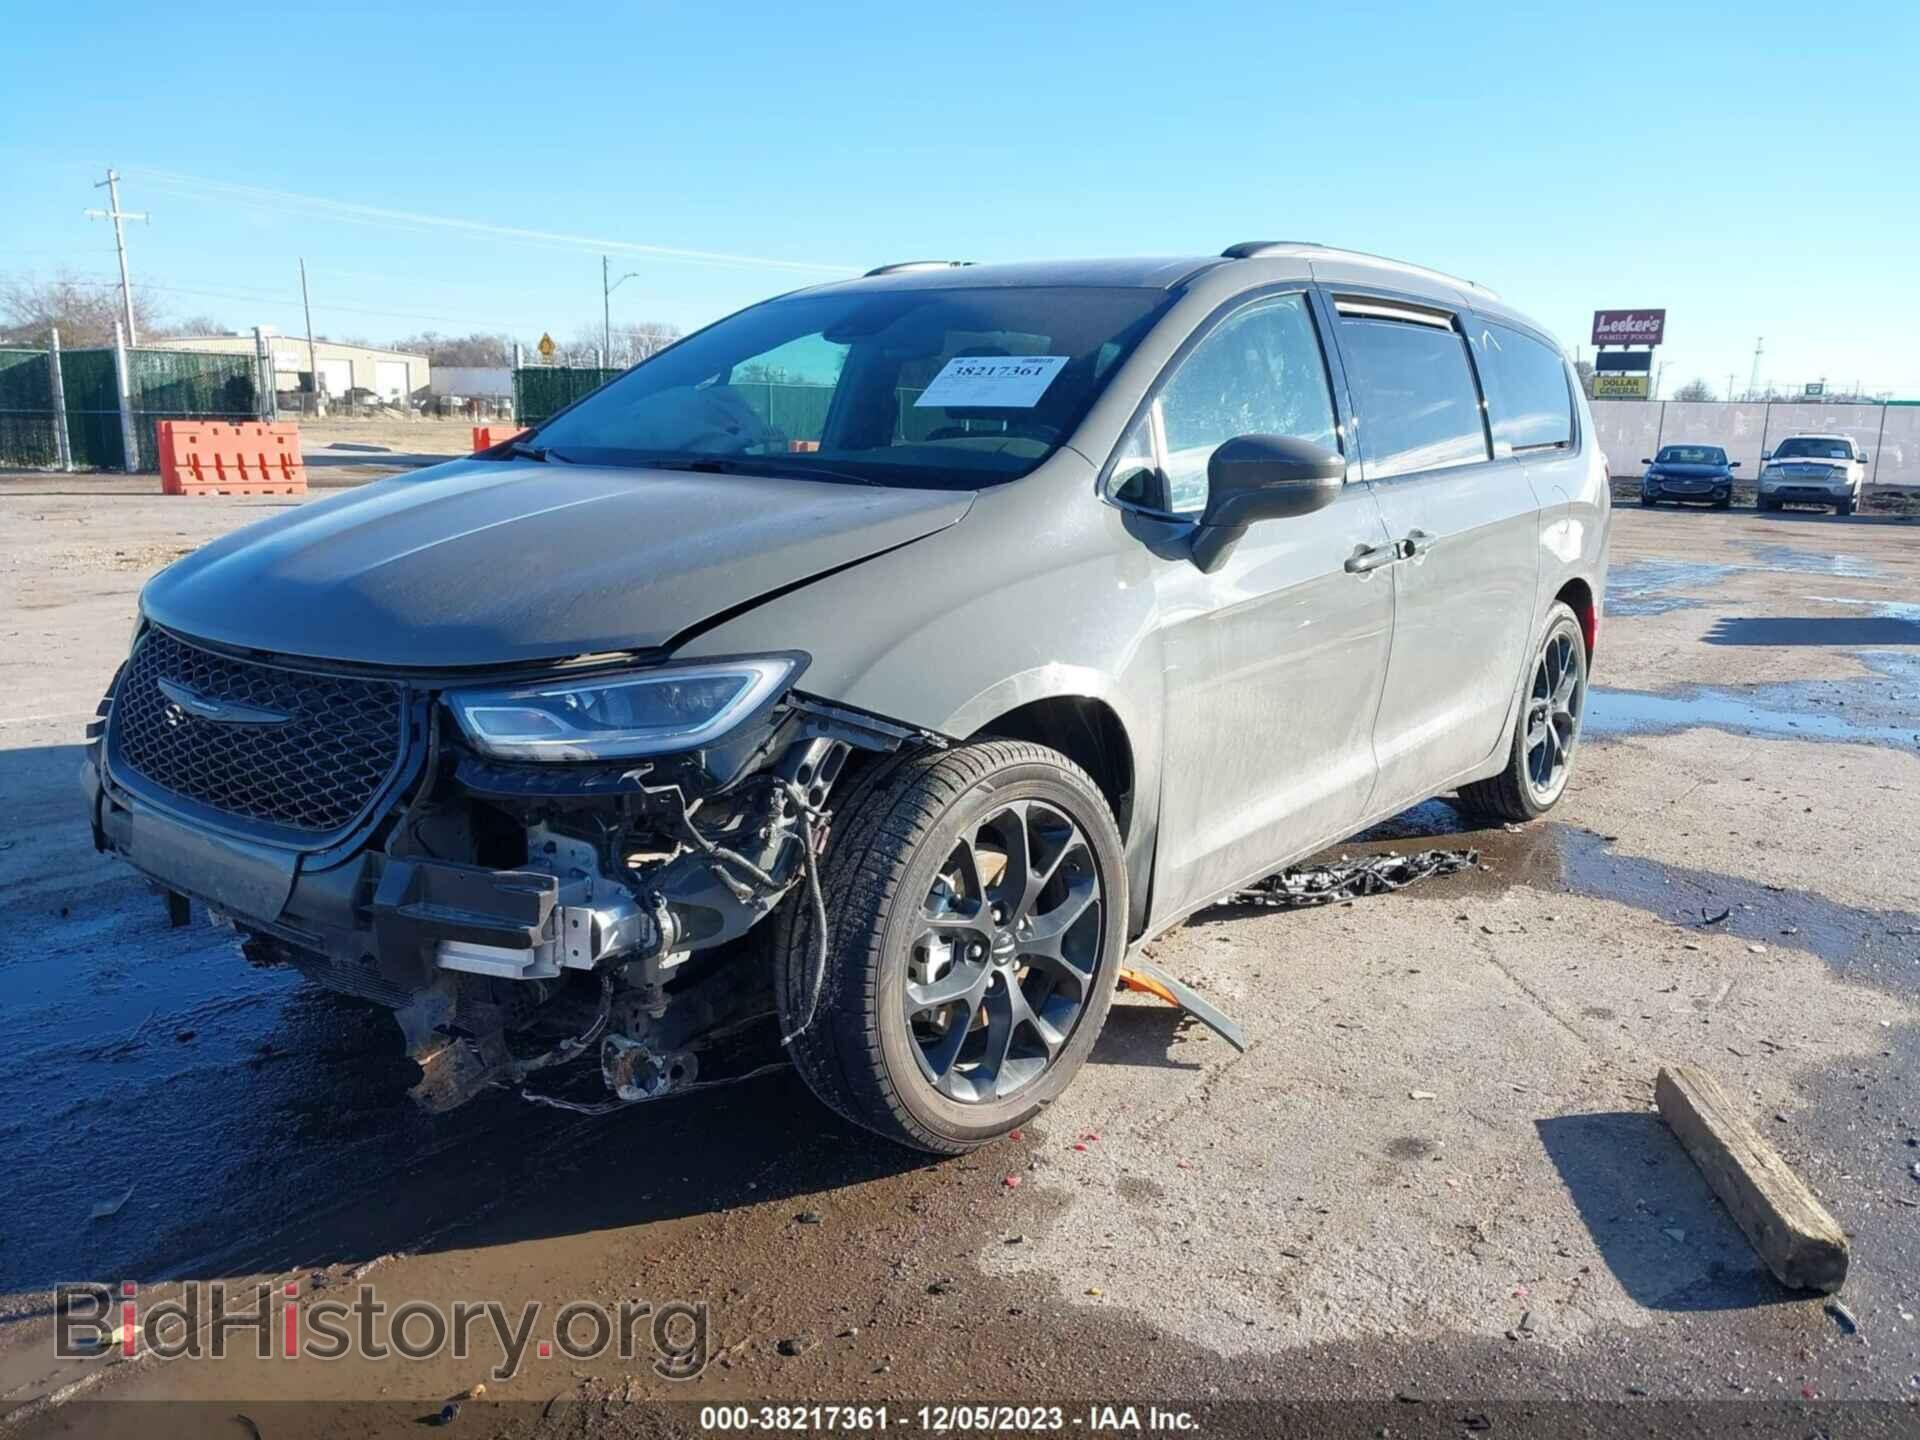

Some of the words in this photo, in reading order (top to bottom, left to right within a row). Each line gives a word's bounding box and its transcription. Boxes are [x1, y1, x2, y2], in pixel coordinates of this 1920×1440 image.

[1596, 314, 1660, 332] Leeker's
[950, 366, 1044, 377] 38217361
[1602, 378, 1640, 386] DOLLAR
